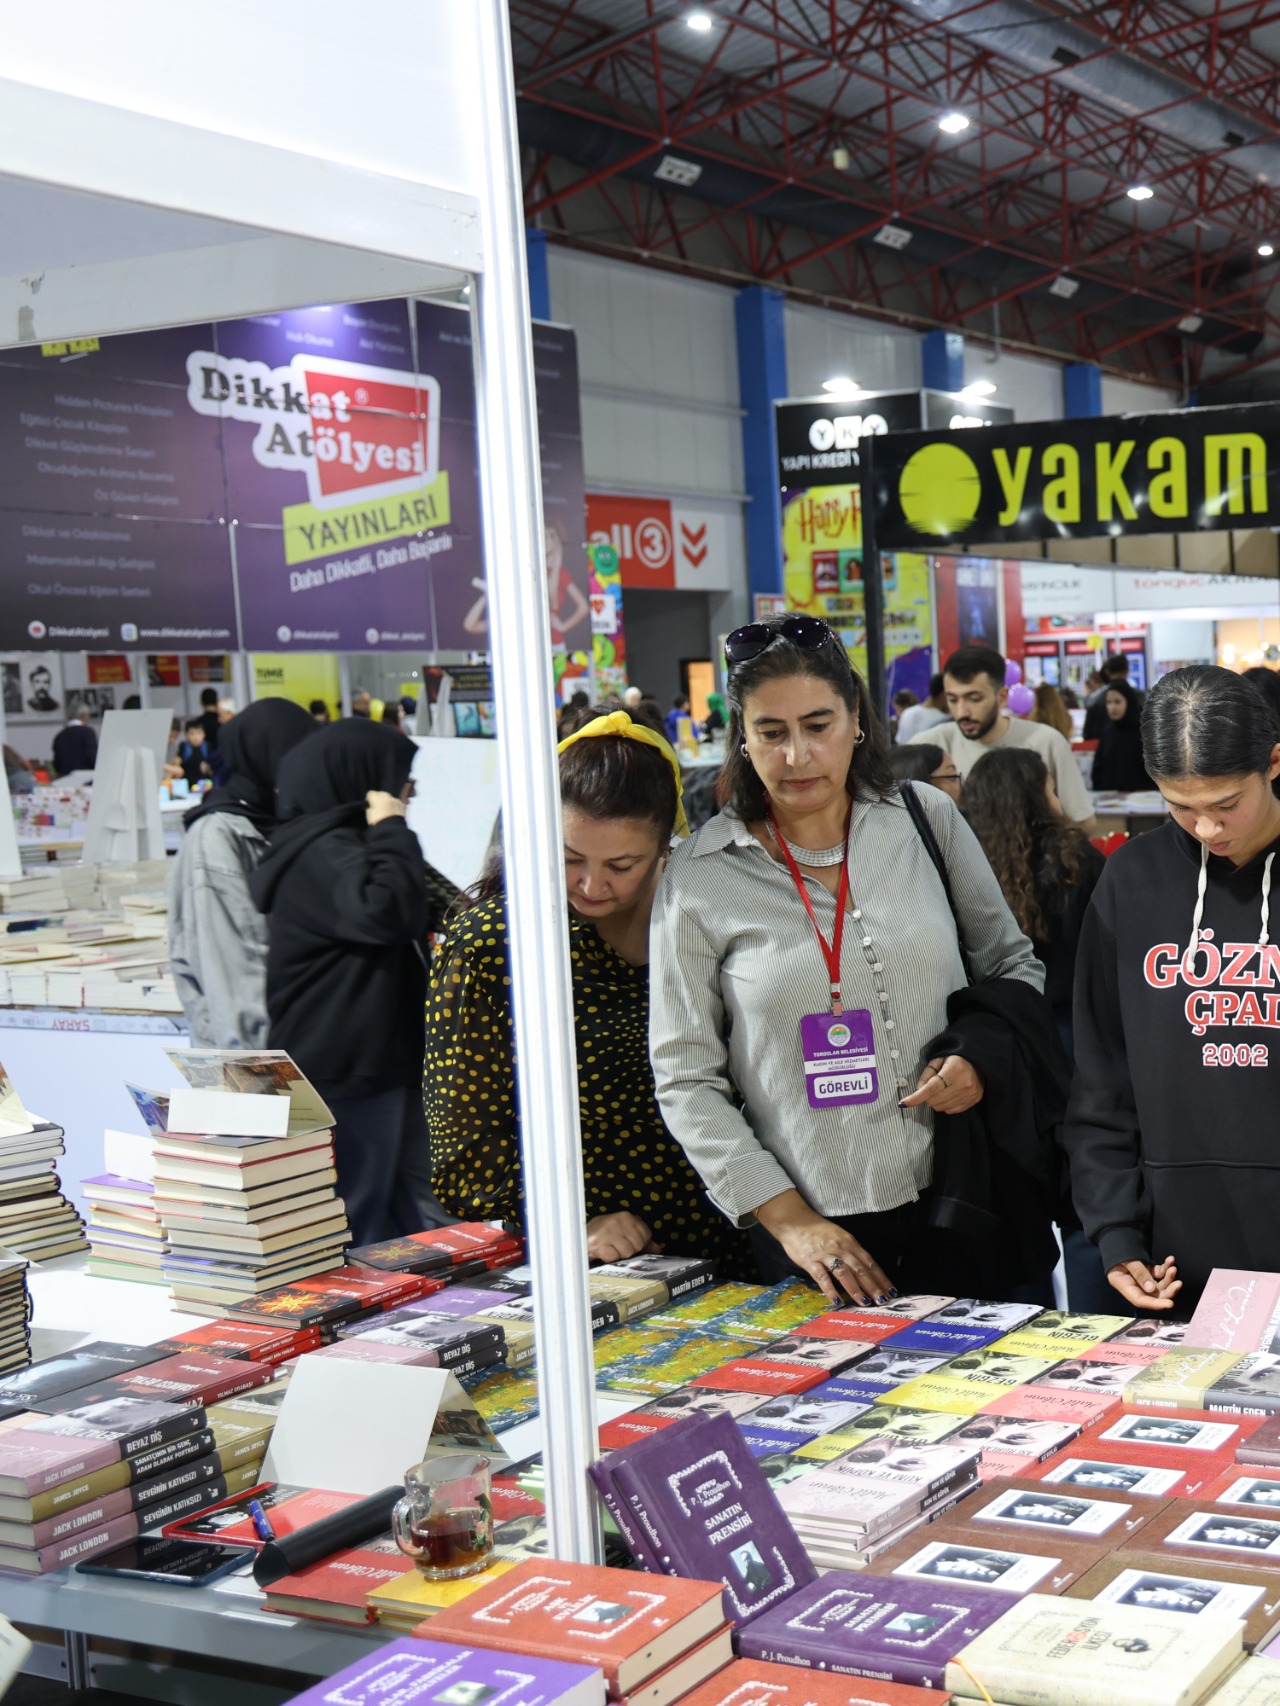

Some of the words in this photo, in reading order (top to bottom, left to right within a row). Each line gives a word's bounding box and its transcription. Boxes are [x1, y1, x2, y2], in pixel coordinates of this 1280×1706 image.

[201, 366, 351, 423] Dikkat
[266, 422, 426, 475] Atölyesi
[781, 455, 811, 471] YAPI
[812, 449, 852, 469] KREDİ
[298, 495, 438, 551] YAYINLARI
[290, 567, 325, 593] Daha
[325, 553, 376, 583] Dikkatli,
[376, 546, 408, 570] Daha
[813, 1049, 840, 1058] TOROSLAR
[840, 1046, 868, 1055] BELEDİYESİ
[1202, 1043, 1268, 1067] 2002
[819, 1076, 869, 1095] GÖREVLİ
[672, 1280, 691, 1297] MARTİN
[692, 1275, 705, 1289] EDEN
[1048, 1331, 1100, 1342] GEZGİN
[444, 1347, 461, 1362] BEYAZ
[461, 1343, 472, 1355] DİŞ
[1209, 1403, 1241, 1415] MARTİN
[126, 1435, 150, 1454] BEYAZ
[150, 1430, 163, 1444] DİŞ
[234, 1446, 251, 1457] JAMES
[251, 1440, 265, 1451] JOYCE
[44, 1470, 59, 1485] JACK
[60, 1462, 85, 1480] LONDON
[242, 1469, 258, 1481] JAMES
[53, 1493, 71, 1505] JAMES
[72, 1484, 90, 1498] JOYCE
[138, 1481, 167, 1502] SEVGİNİN
[168, 1471, 197, 1491] KATIKSIZI
[706, 1479, 731, 1499] Proudhon
[143, 1504, 173, 1525] SEVGİNİN
[173, 1493, 202, 1514] KATIKSIZI
[605, 1493, 612, 1504] P.
[613, 1508, 636, 1546] Proudhon
[704, 1502, 743, 1530] SANATIN
[53, 1520, 71, 1537] JACK
[72, 1508, 104, 1529] LONDON
[630, 1494, 638, 1506] P.
[638, 1510, 662, 1549] Proudhon
[708, 1511, 753, 1546] PRENSİBİ
[59, 1543, 79, 1561] JACK
[79, 1532, 110, 1554] LONDON
[761, 1650, 769, 1659] P.
[776, 1652, 811, 1667] Proudhon
[831, 1663, 862, 1676] SANATIN
[862, 1669, 893, 1681] PRENSİBİ
